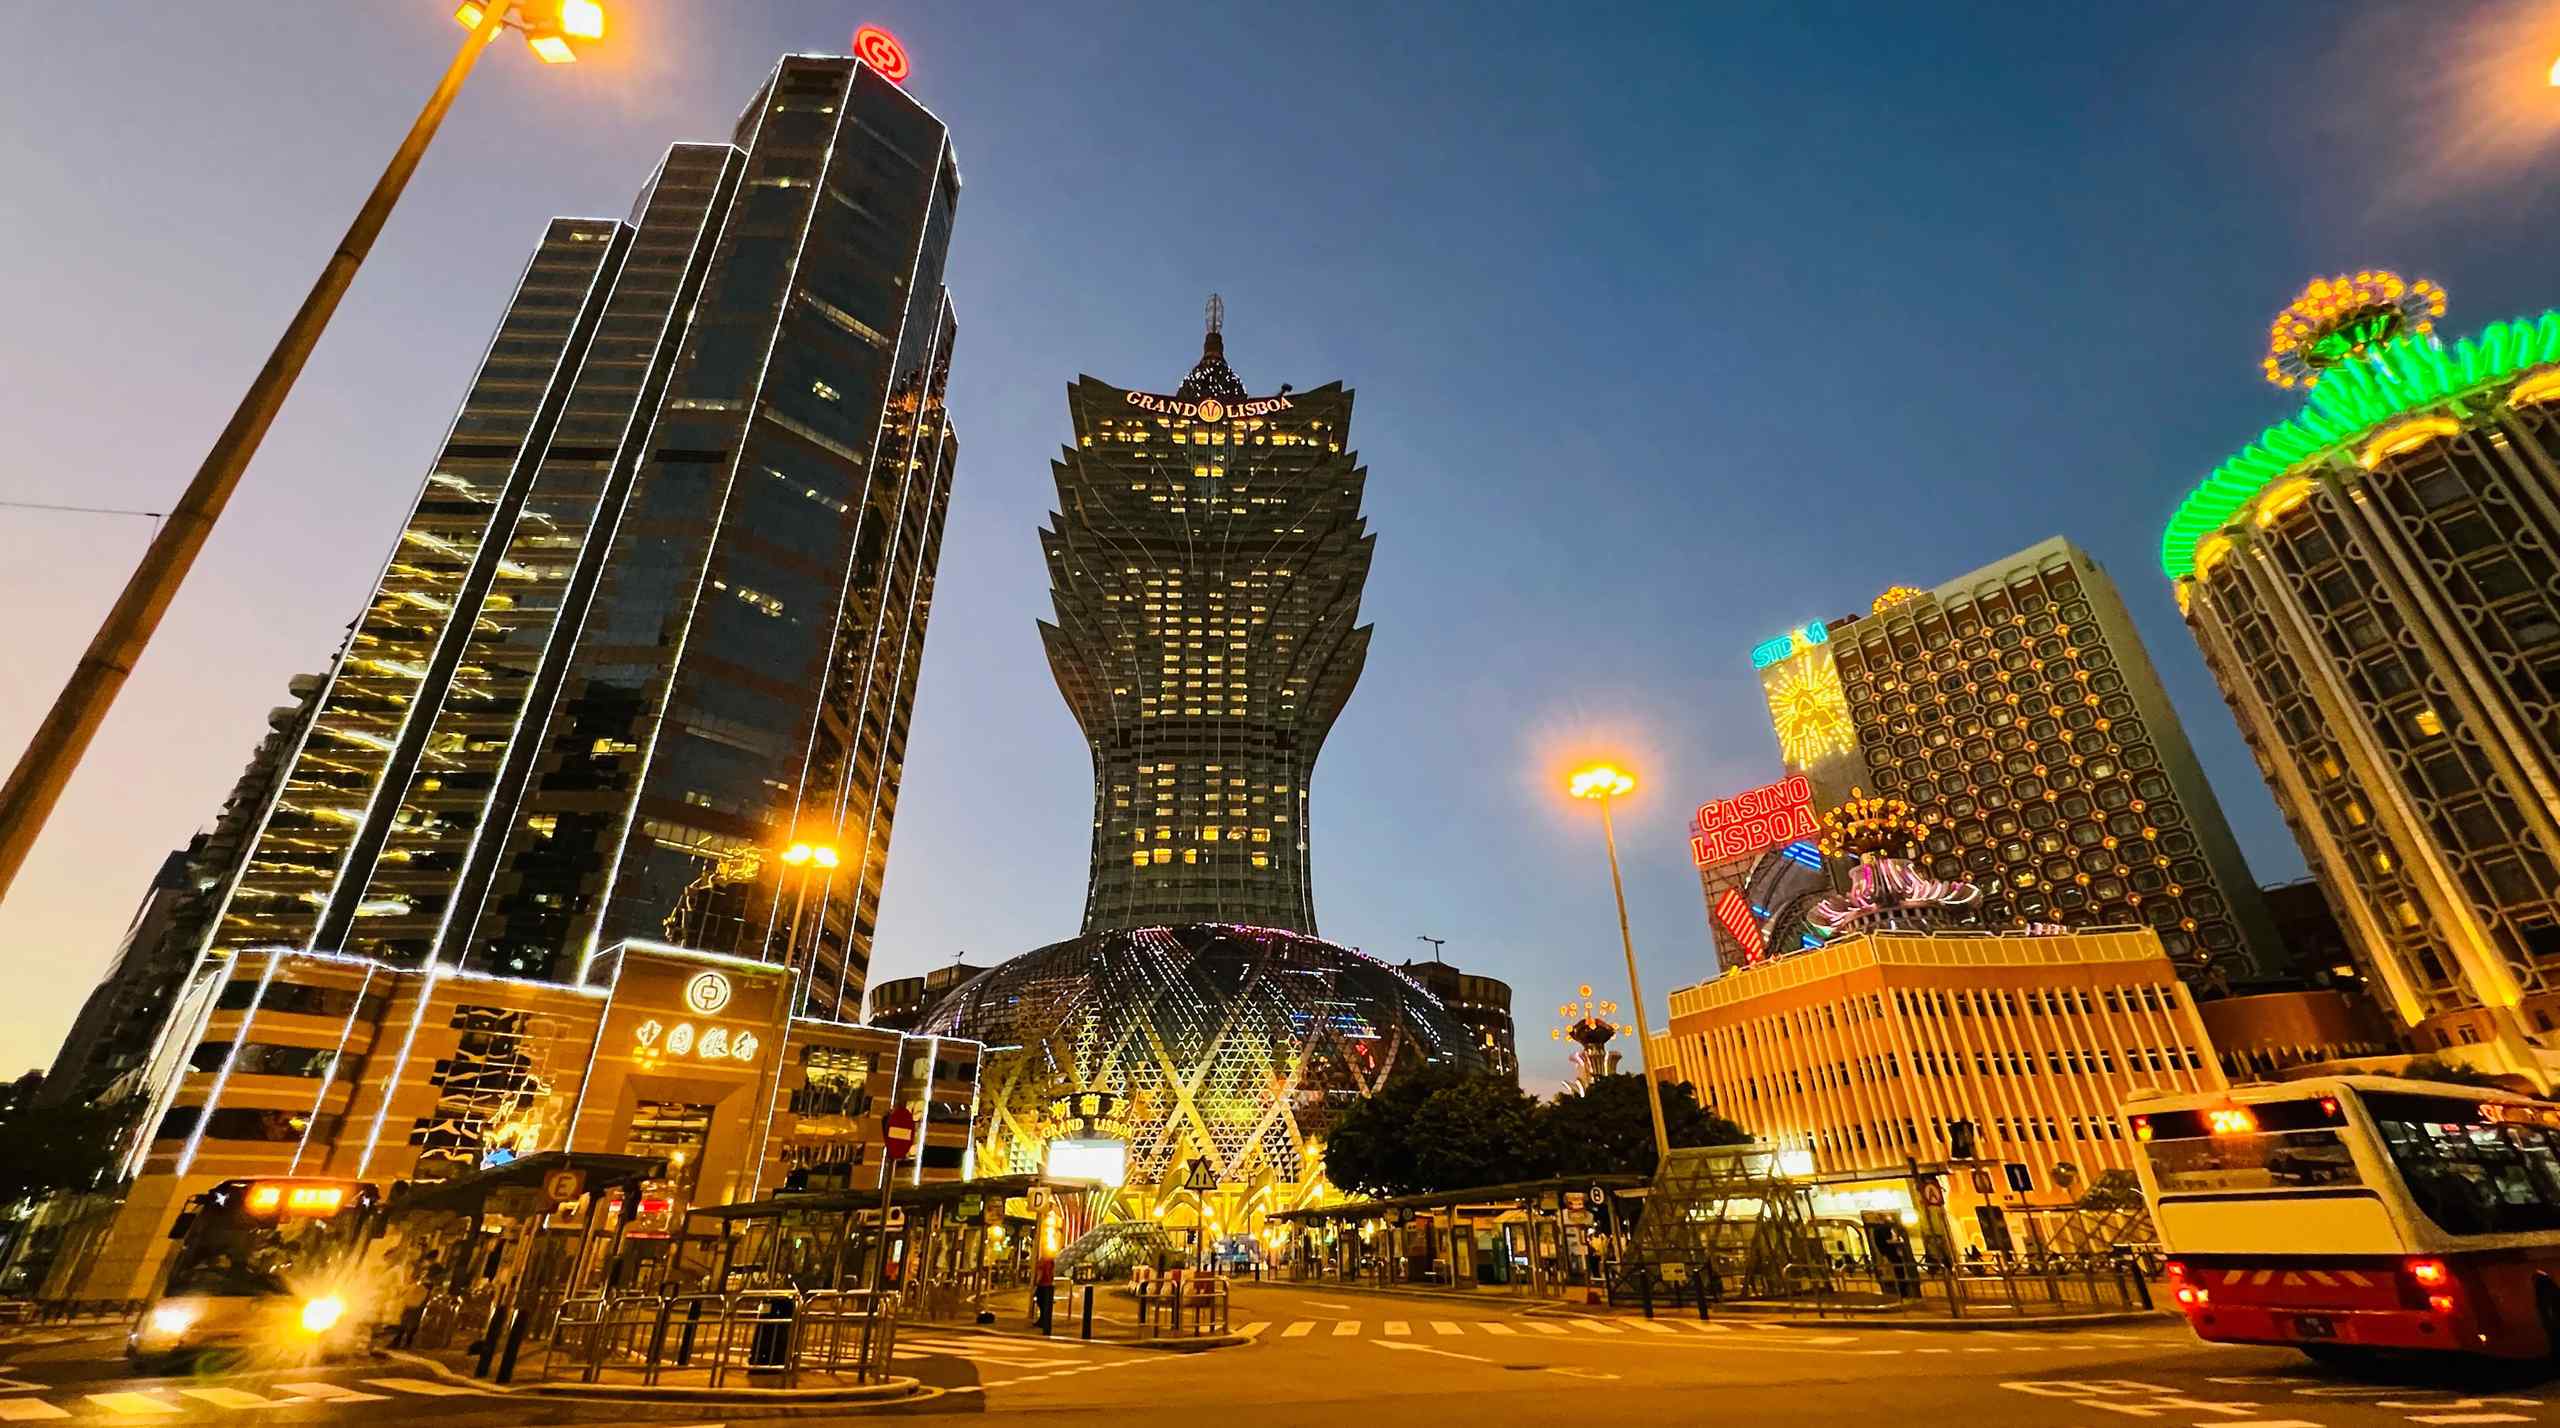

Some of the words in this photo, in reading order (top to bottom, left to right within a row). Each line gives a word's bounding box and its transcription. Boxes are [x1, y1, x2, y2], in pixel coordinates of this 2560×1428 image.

[1126, 391, 1198, 418] GRAND
[1226, 396, 1294, 419] LISBOA
[1700, 776, 1811, 832] CASINO
[1690, 805, 1821, 865] LISBOA
[1042, 1118, 1085, 1138] GRAND
[1093, 1117, 1133, 1139] LISBOA
[554, 1175, 574, 1198] E
[1034, 1191, 1043, 1207] D
